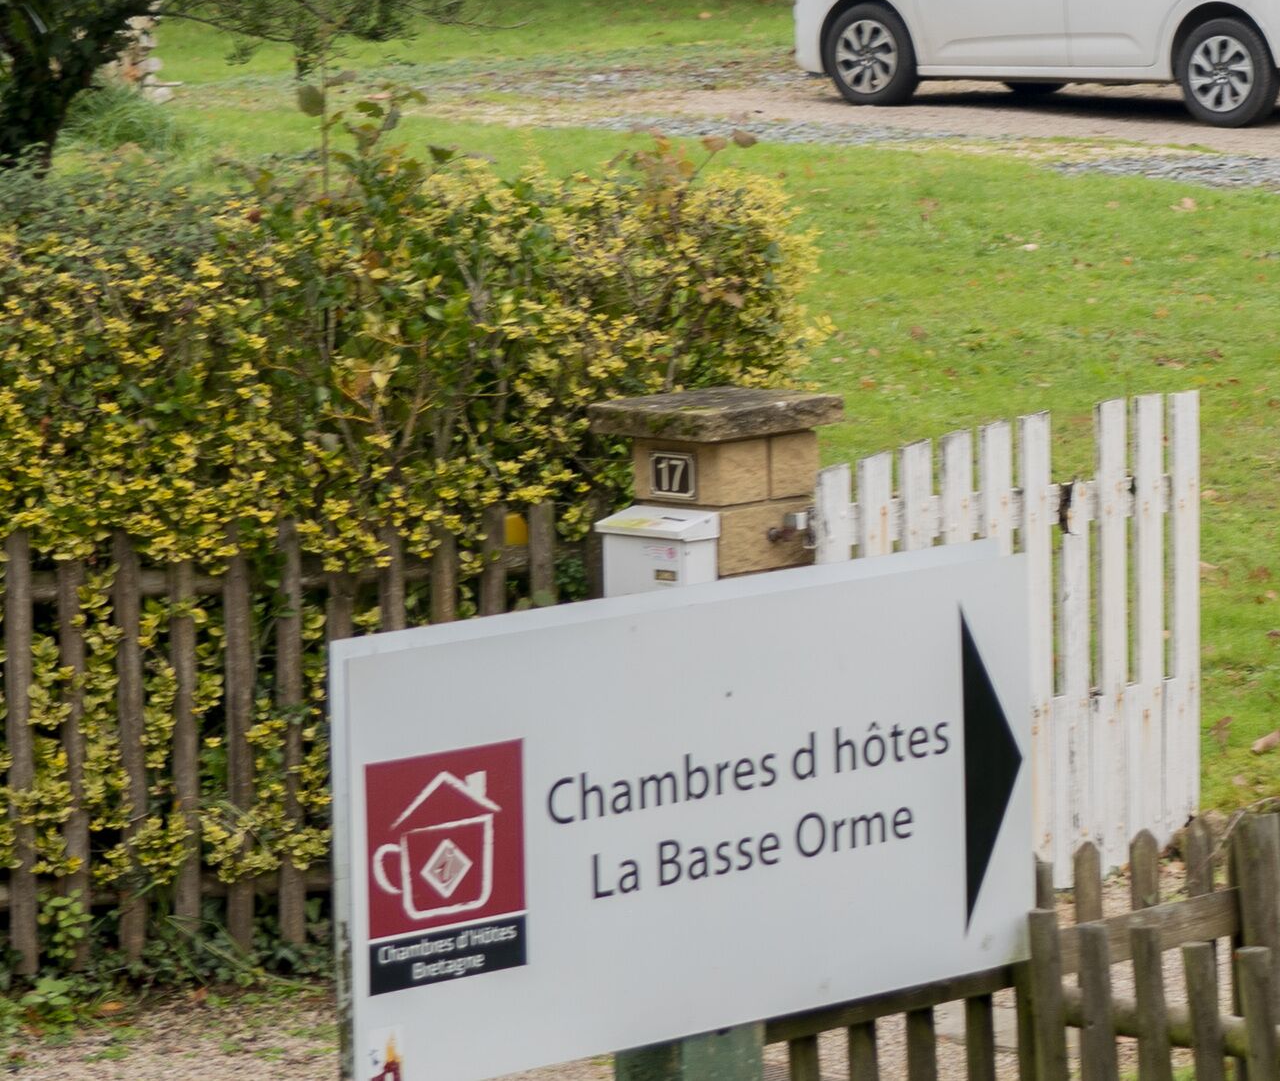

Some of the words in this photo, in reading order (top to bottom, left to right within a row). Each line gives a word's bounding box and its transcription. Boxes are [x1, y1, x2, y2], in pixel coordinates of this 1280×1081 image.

[657, 459, 685, 491] 17
[546, 753, 778, 825] Chambres
[791, 731, 817, 781] d
[833, 721, 951, 774] hôtes
[591, 853, 641, 900] La
[657, 831, 782, 887] Basse
[795, 806, 914, 858] Orme
[378, 938, 454, 964] Chambres
[456, 925, 517, 948] d'Hôtes
[412, 954, 485, 980] Bretagne
